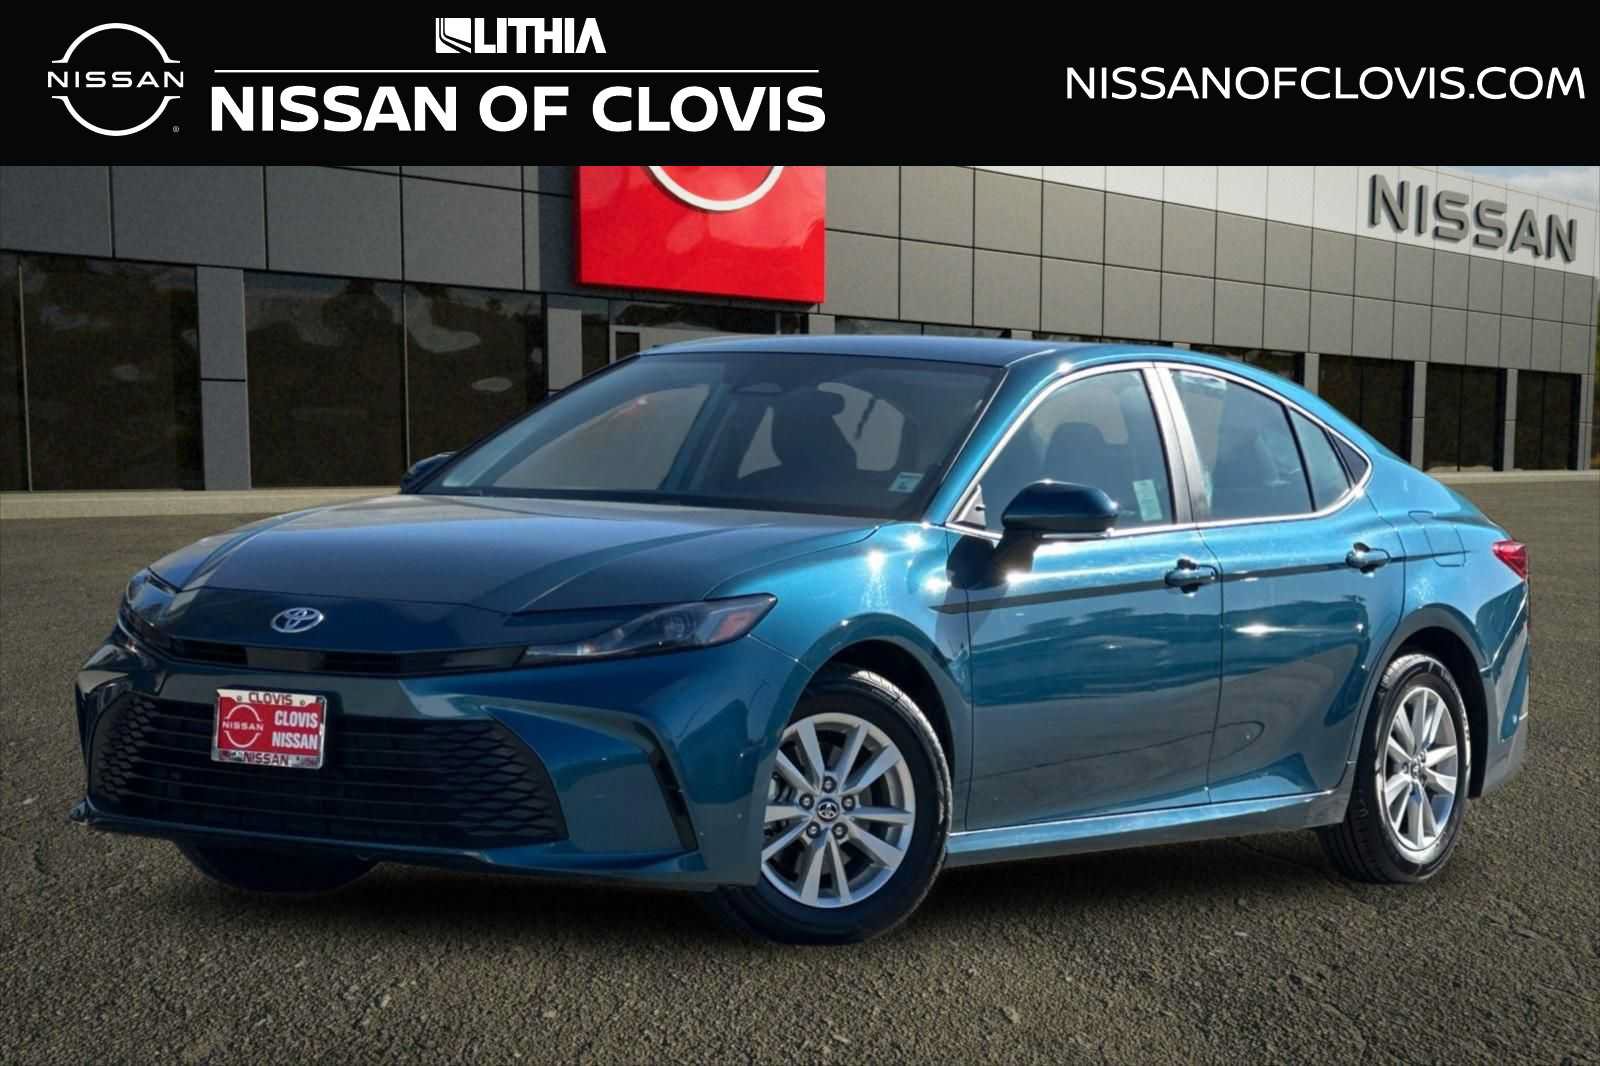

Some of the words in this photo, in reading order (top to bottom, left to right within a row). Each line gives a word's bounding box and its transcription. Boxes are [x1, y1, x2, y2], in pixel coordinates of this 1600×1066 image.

[1368, 174, 1577, 263] NISSAN
[248, 692, 292, 705] CLOVIS
[222, 720, 264, 731] NISSAN
[274, 710, 319, 729] CLOVIS
[271, 732, 318, 750] NISSAN
[243, 752, 289, 766] NISSAN
